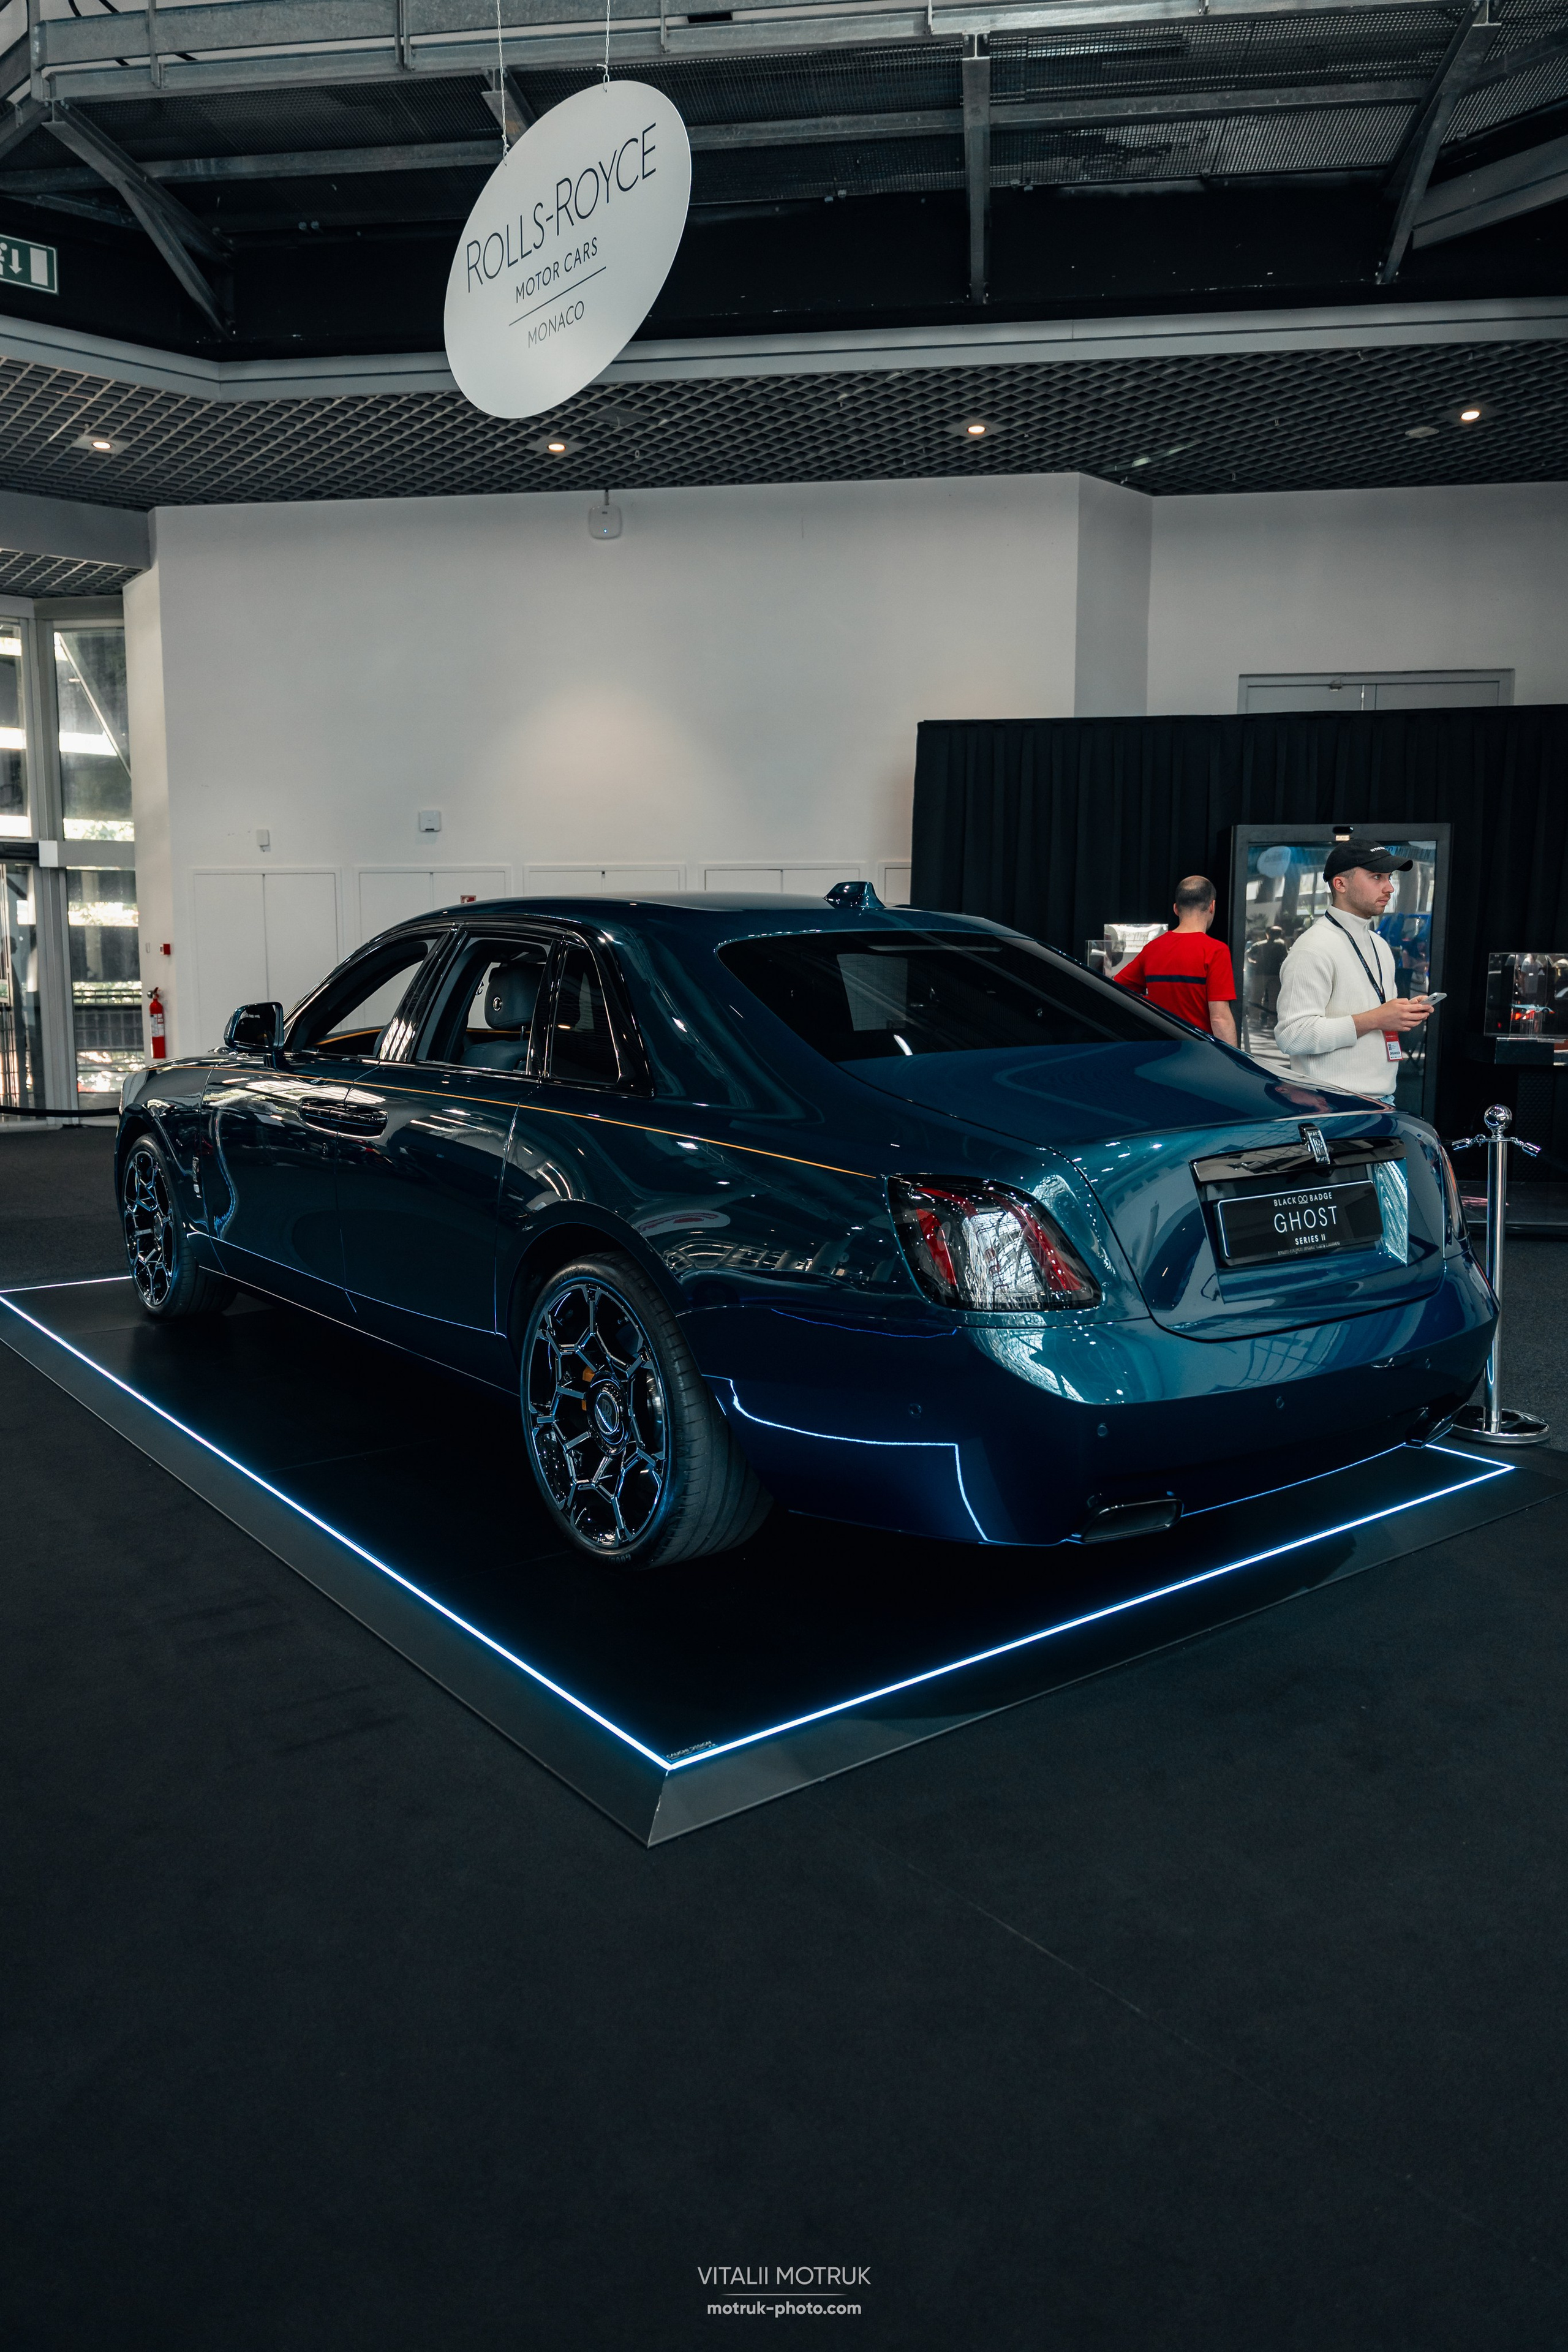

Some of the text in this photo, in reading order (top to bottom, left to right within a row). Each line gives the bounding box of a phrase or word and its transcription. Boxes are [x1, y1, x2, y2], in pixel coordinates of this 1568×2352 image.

[467, 122, 657, 293] ROLLS-ROYCE
[516, 236, 598, 304] MOTOR CARS
[527, 300, 584, 349] MONACO
[1273, 1192, 1332, 1207] BLACK BADGE
[1274, 1205, 1337, 1233] GHOST
[1294, 1234, 1319, 1245] SERIES
